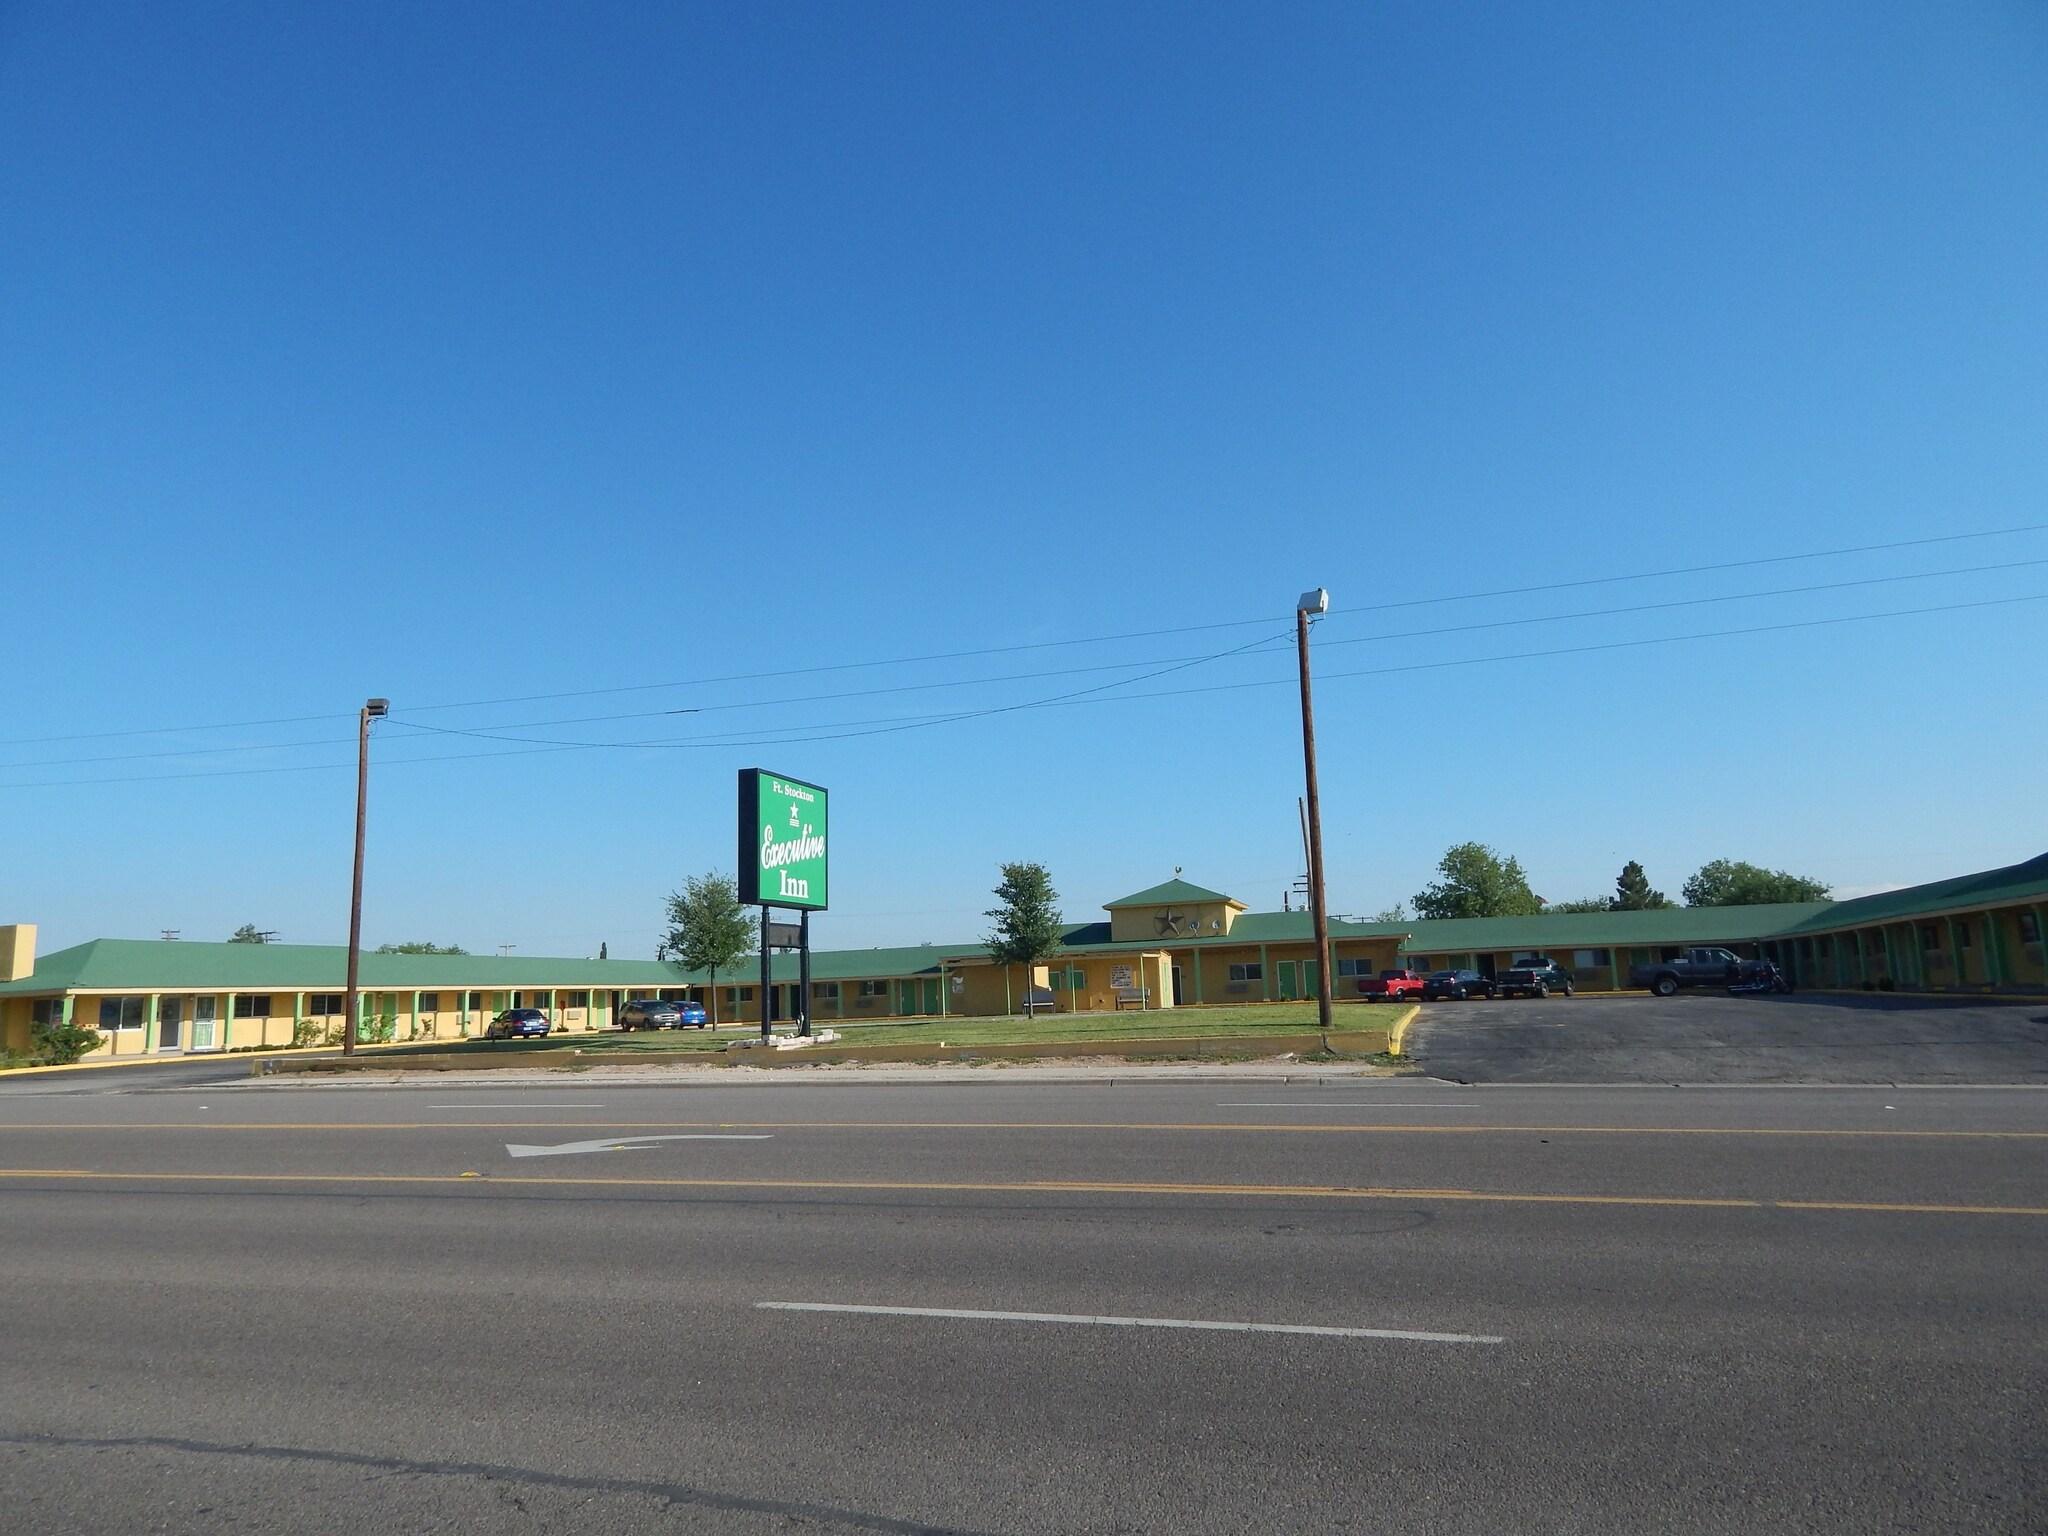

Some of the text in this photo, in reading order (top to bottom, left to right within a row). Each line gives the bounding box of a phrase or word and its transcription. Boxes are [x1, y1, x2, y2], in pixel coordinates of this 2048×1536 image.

[773, 781, 814, 802] Ft. Stockton
[761, 823, 825, 869] Executive
[780, 869, 808, 898] Inn
